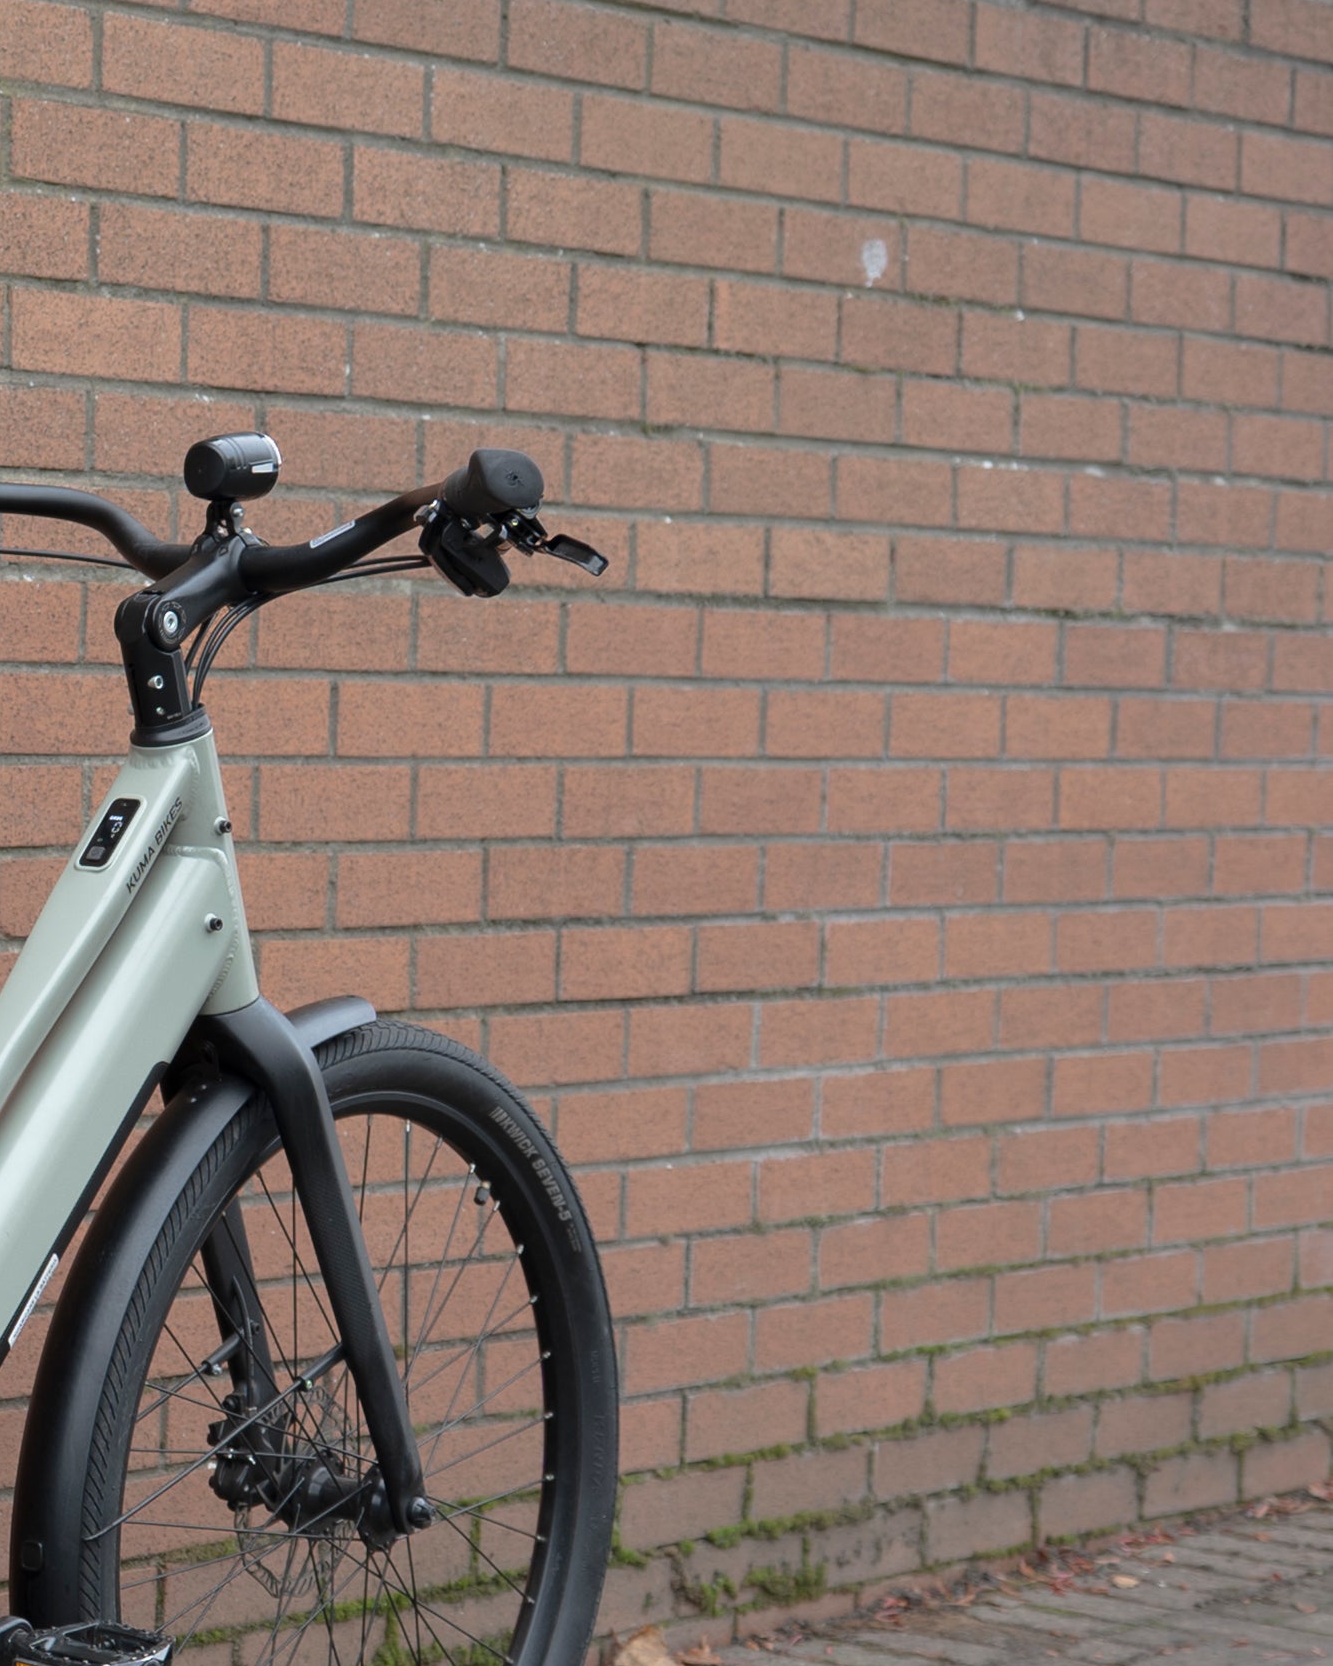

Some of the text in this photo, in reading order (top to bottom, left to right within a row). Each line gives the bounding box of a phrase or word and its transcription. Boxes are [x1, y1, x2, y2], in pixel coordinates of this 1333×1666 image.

[125, 797, 183, 894] KUMA BIKES
[499, 1118, 538, 1159] KWICK
